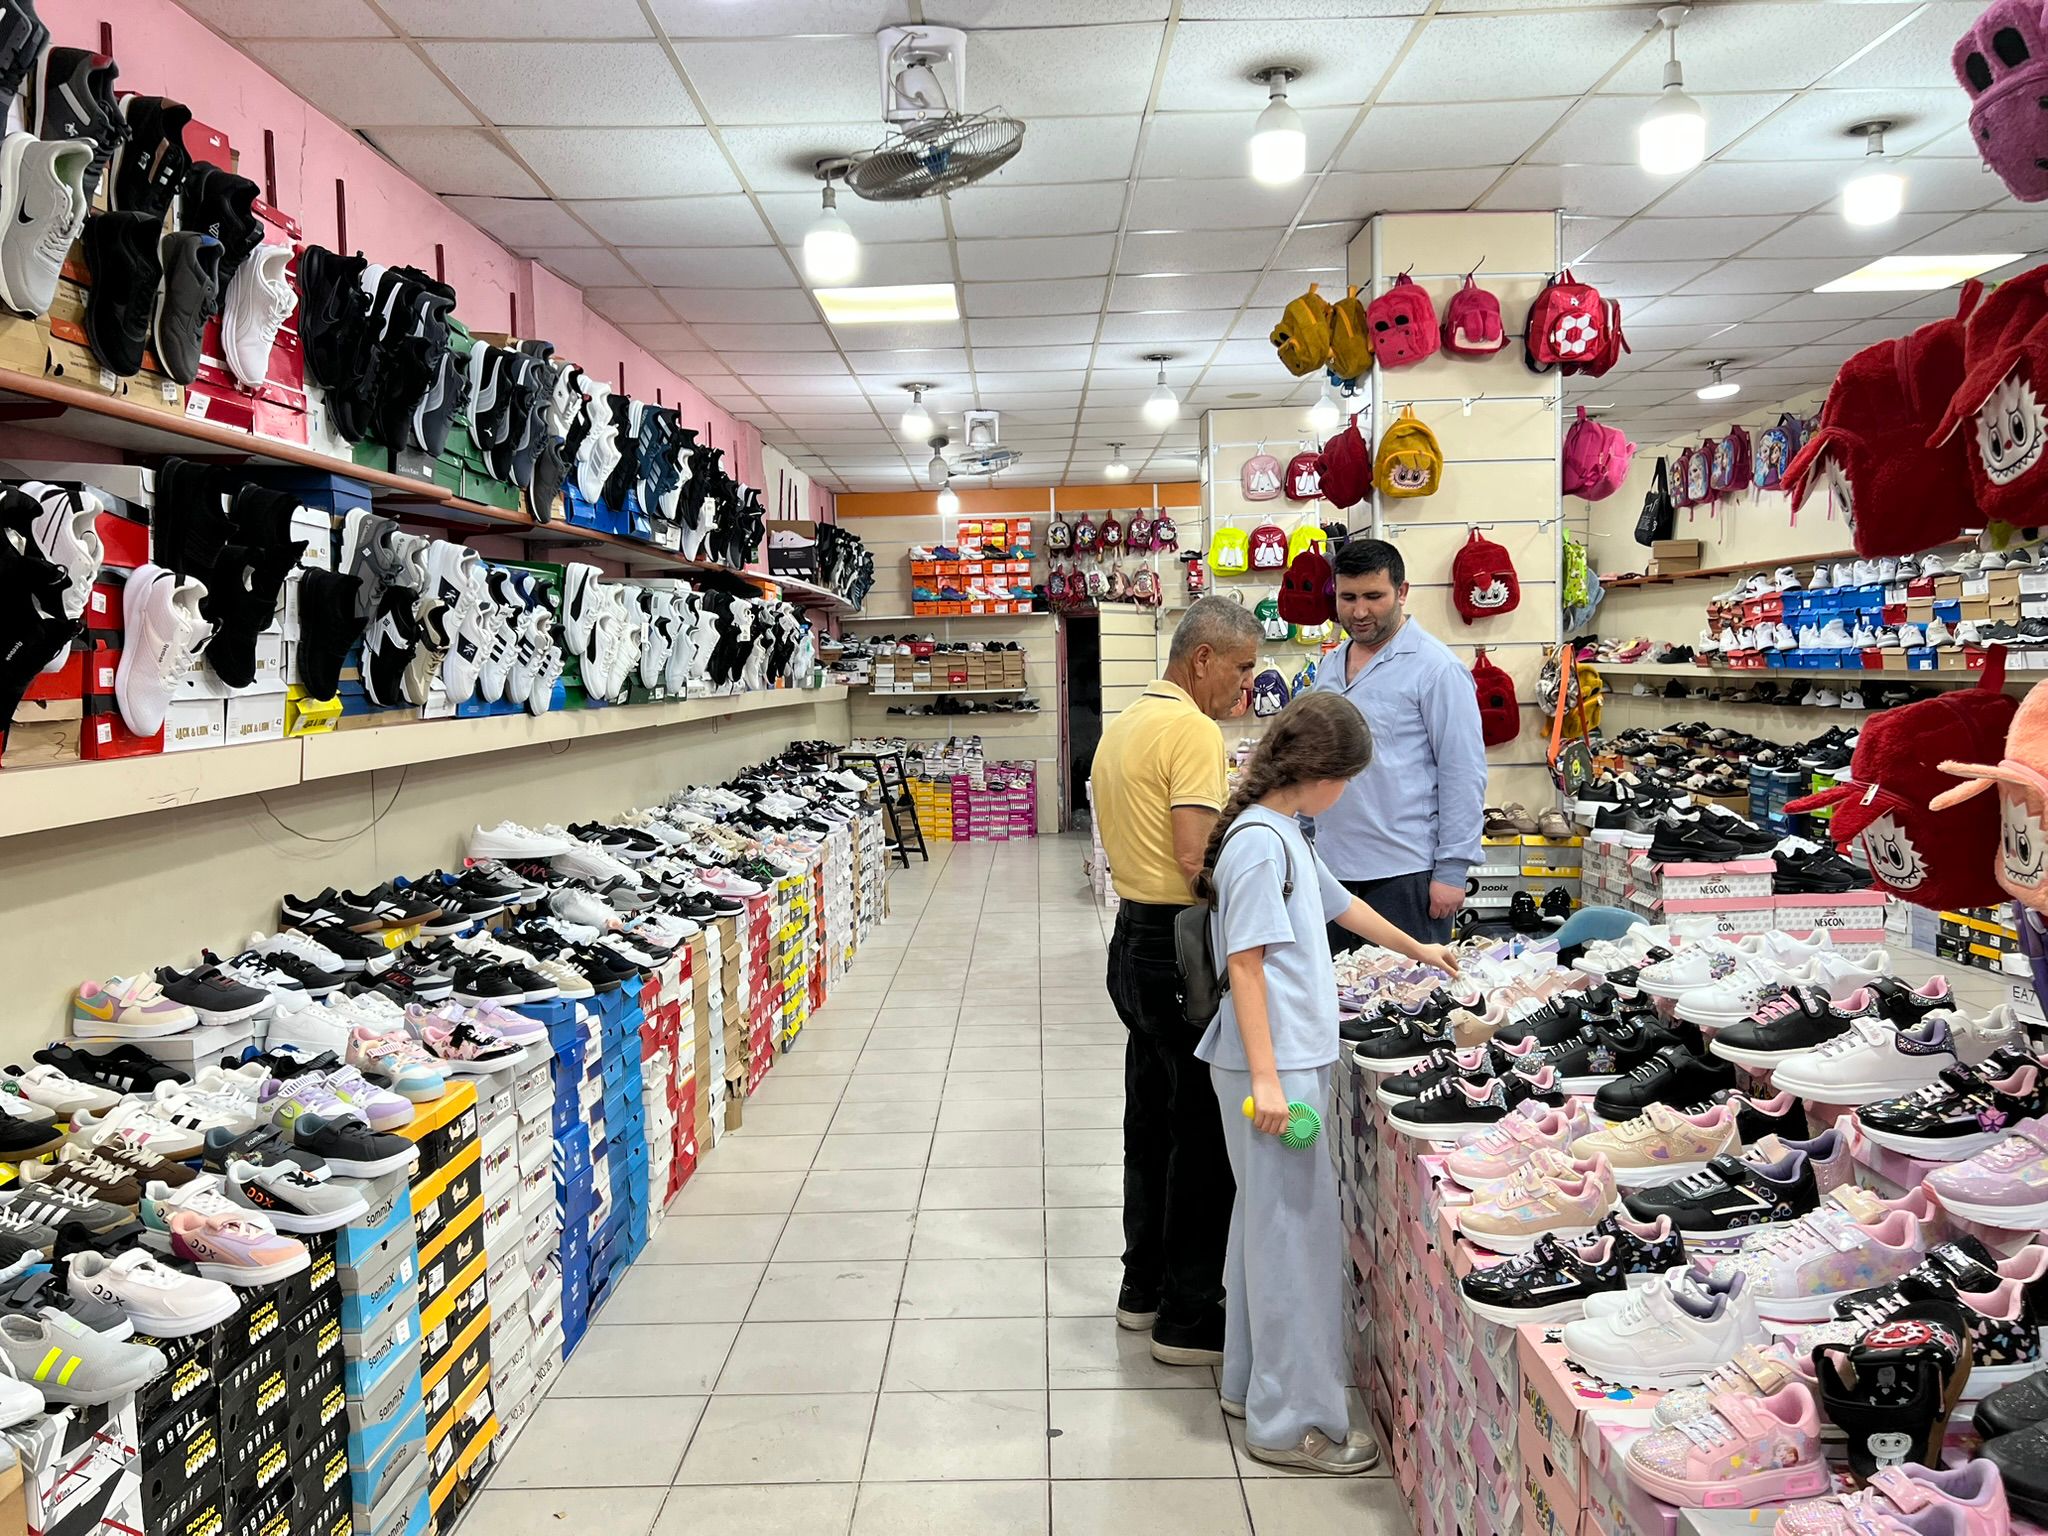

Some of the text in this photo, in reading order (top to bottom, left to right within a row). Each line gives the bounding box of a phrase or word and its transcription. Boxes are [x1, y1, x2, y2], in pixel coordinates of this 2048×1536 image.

[270, 658, 277, 666] 42
[175, 727, 190, 740] JACK
[197, 725, 208, 736] LION
[240, 724, 253, 736] JACK
[259, 722, 269, 732] LION
[1700, 884, 1731, 895] NESCON
[1814, 918, 1845, 927] NESCON
[2012, 985, 2036, 1002] EA7
[247, 1187, 275, 1208] DDX
[190, 1239, 218, 1260] DDX
[92, 1284, 124, 1307] DDX
